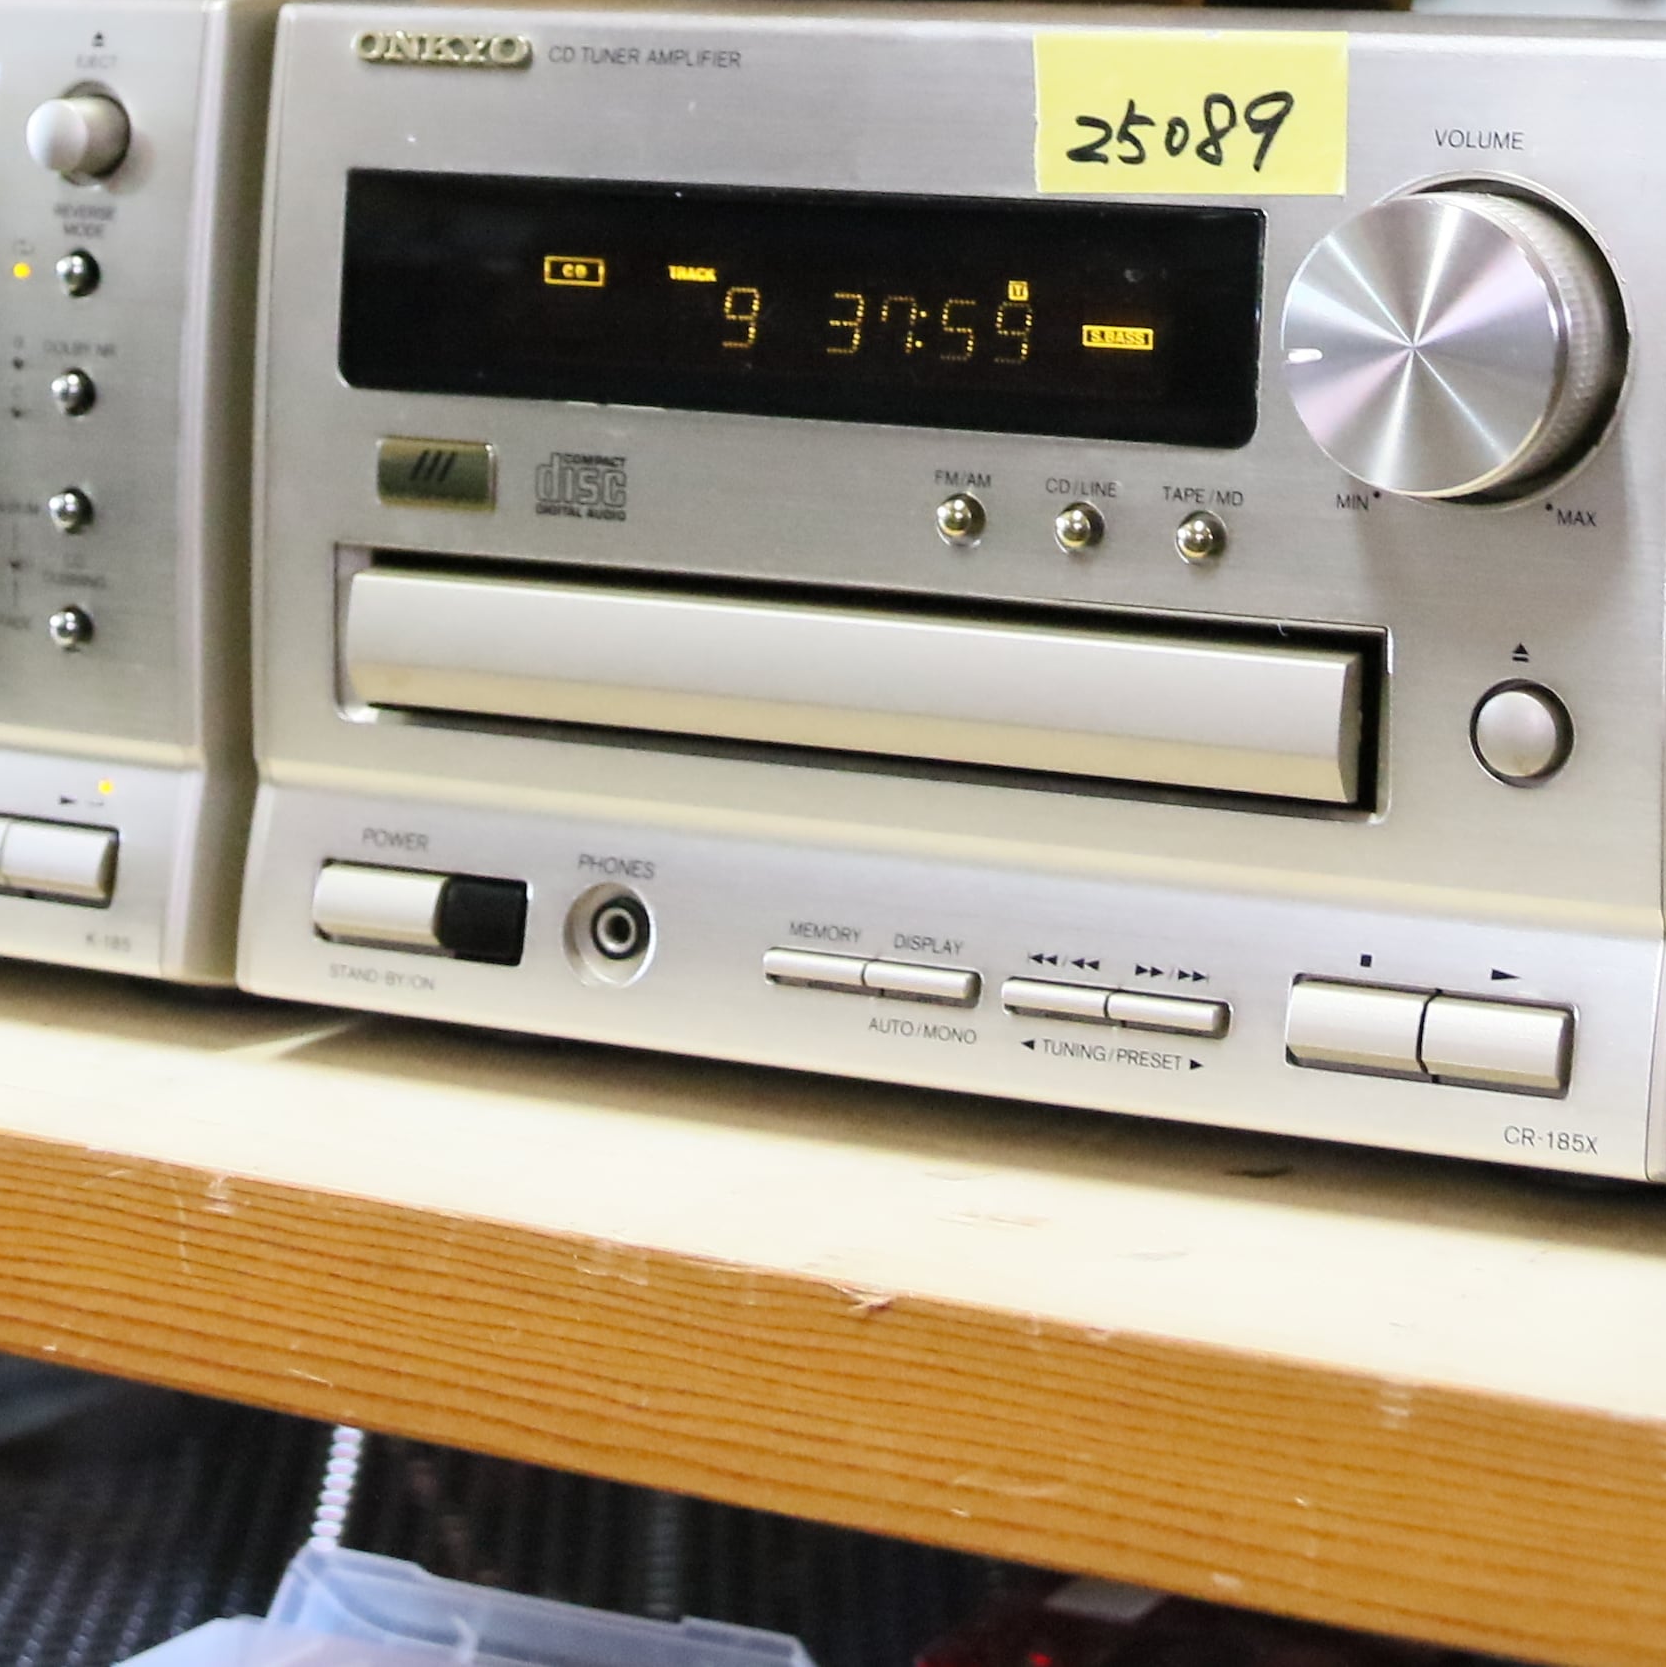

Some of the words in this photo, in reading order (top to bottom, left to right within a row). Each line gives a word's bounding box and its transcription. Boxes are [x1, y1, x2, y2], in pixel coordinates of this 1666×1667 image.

[351, 30, 534, 70] ONKYO
[548, 44, 577, 65] CD
[583, 47, 641, 66] TUNER
[646, 48, 743, 70] AMPLIFIER
[1065, 90, 1295, 173] 25089
[1434, 128, 1525, 151] VOLUME
[668, 264, 719, 282] TRACK
[722, 285, 761, 348] 9
[826, 291, 1034, 364] 37:59
[1089, 328, 1147, 347] S.BASS
[560, 452, 627, 469] COMPACT
[934, 468, 993, 489] FM/AM
[1044, 476, 1118, 499] CD/LINE
[1162, 484, 1245, 508] TAPE/MD
[1335, 493, 1370, 512] MIN
[535, 501, 583, 519] DIGITAL
[585, 505, 627, 523] AUDIO
[1556, 508, 1597, 528] MAX
[361, 827, 430, 852] POWER
[577, 852, 656, 880] PHONES
[789, 920, 863, 944] MEMORY
[893, 932, 965, 957] DISPLAY
[868, 1016, 978, 1046] AUTO/MONO
[1041, 1037, 1184, 1072] TUNING/PRESET
[1502, 1124, 1599, 1156] CR-185X
